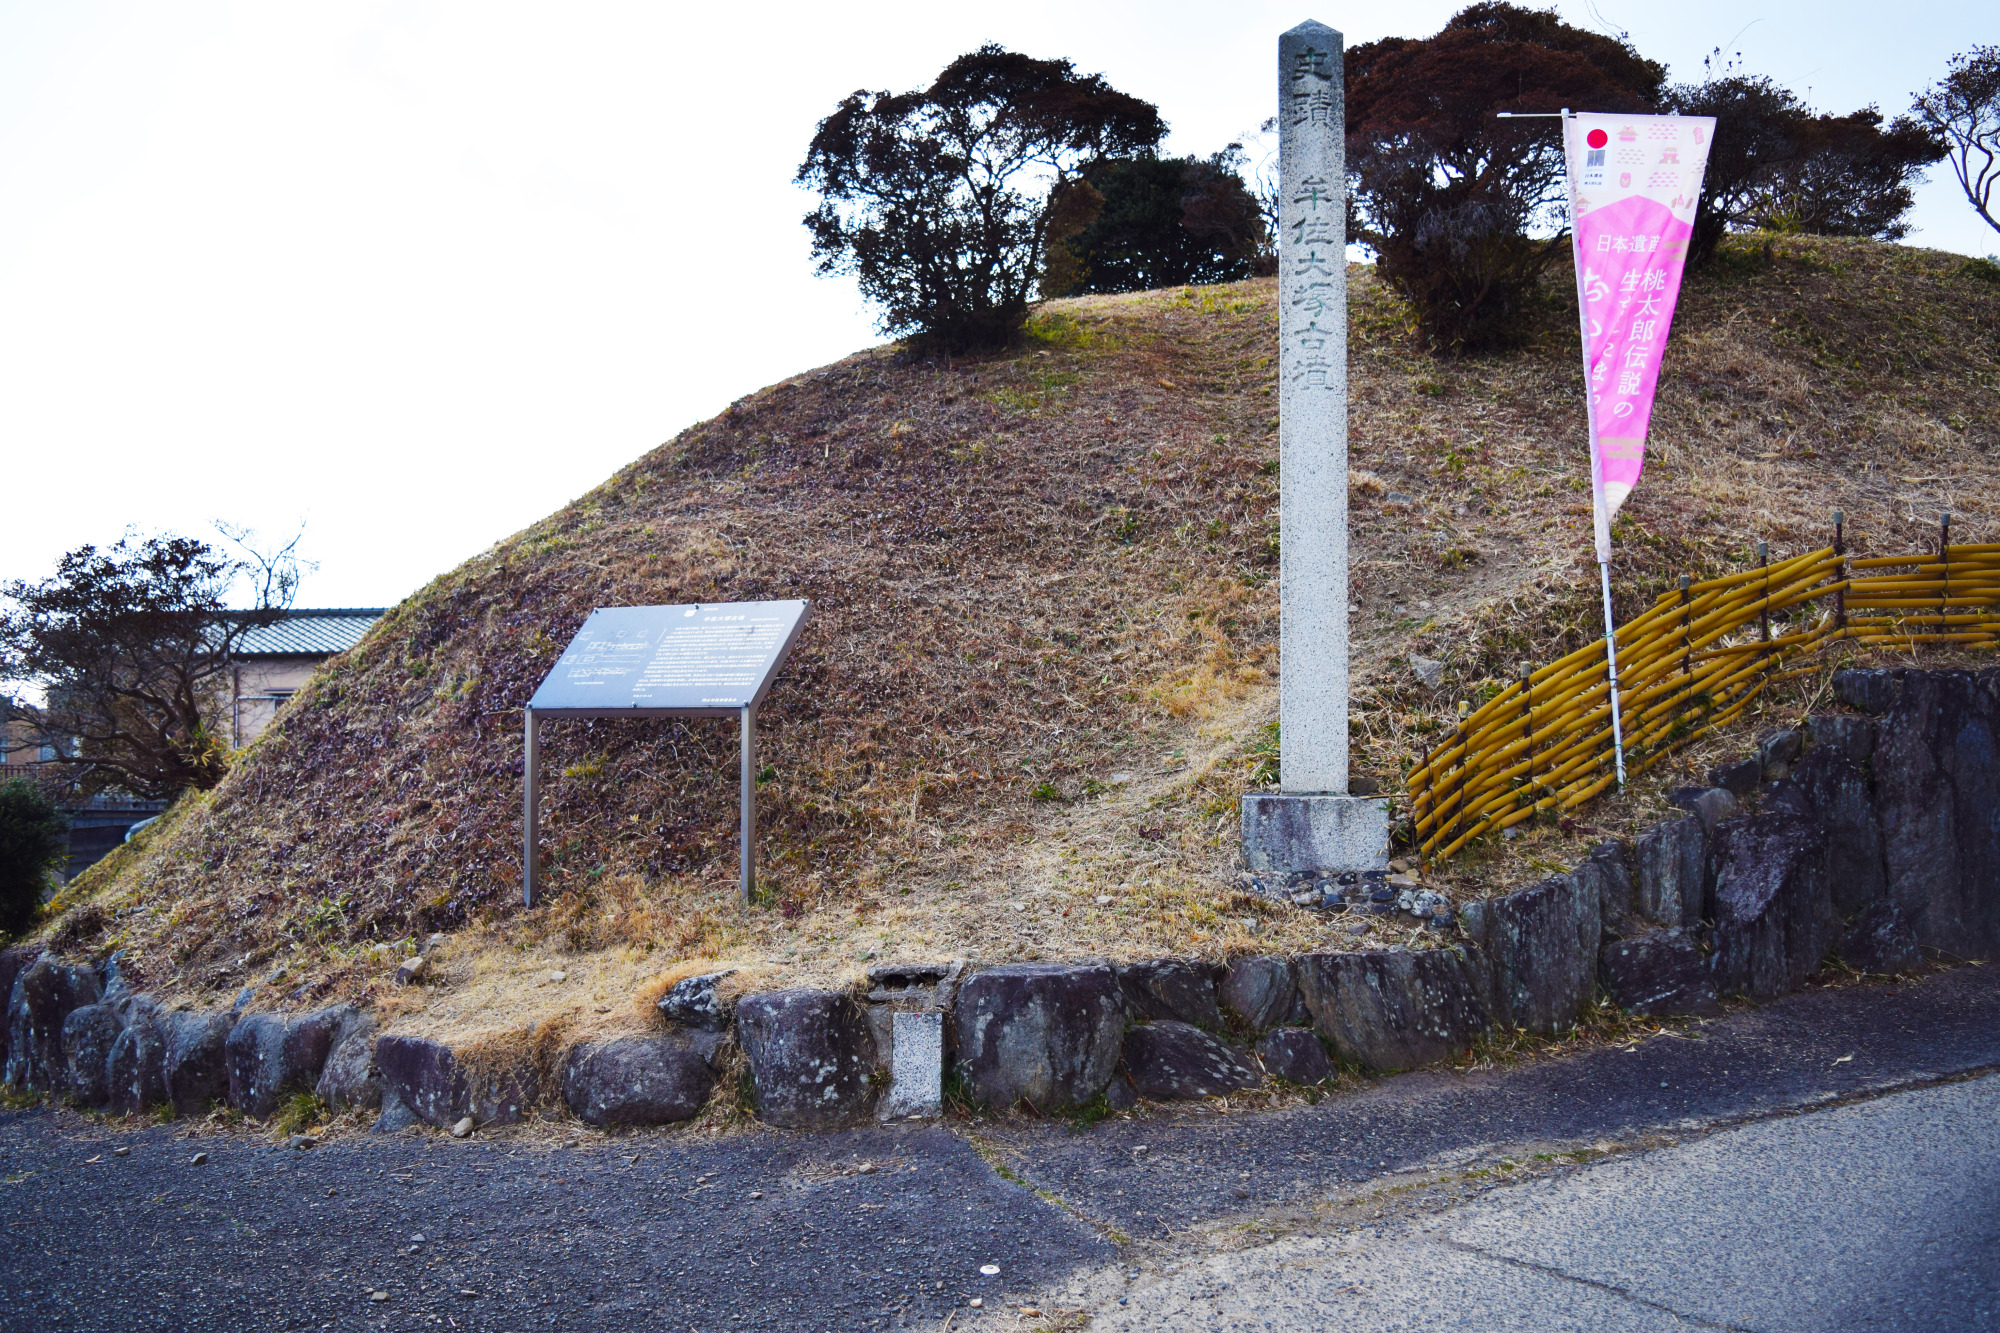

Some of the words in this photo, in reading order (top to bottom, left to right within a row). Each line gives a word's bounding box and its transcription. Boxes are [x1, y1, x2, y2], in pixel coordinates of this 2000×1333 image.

[1613, 268, 1667, 418] 桃太郎伝説の
